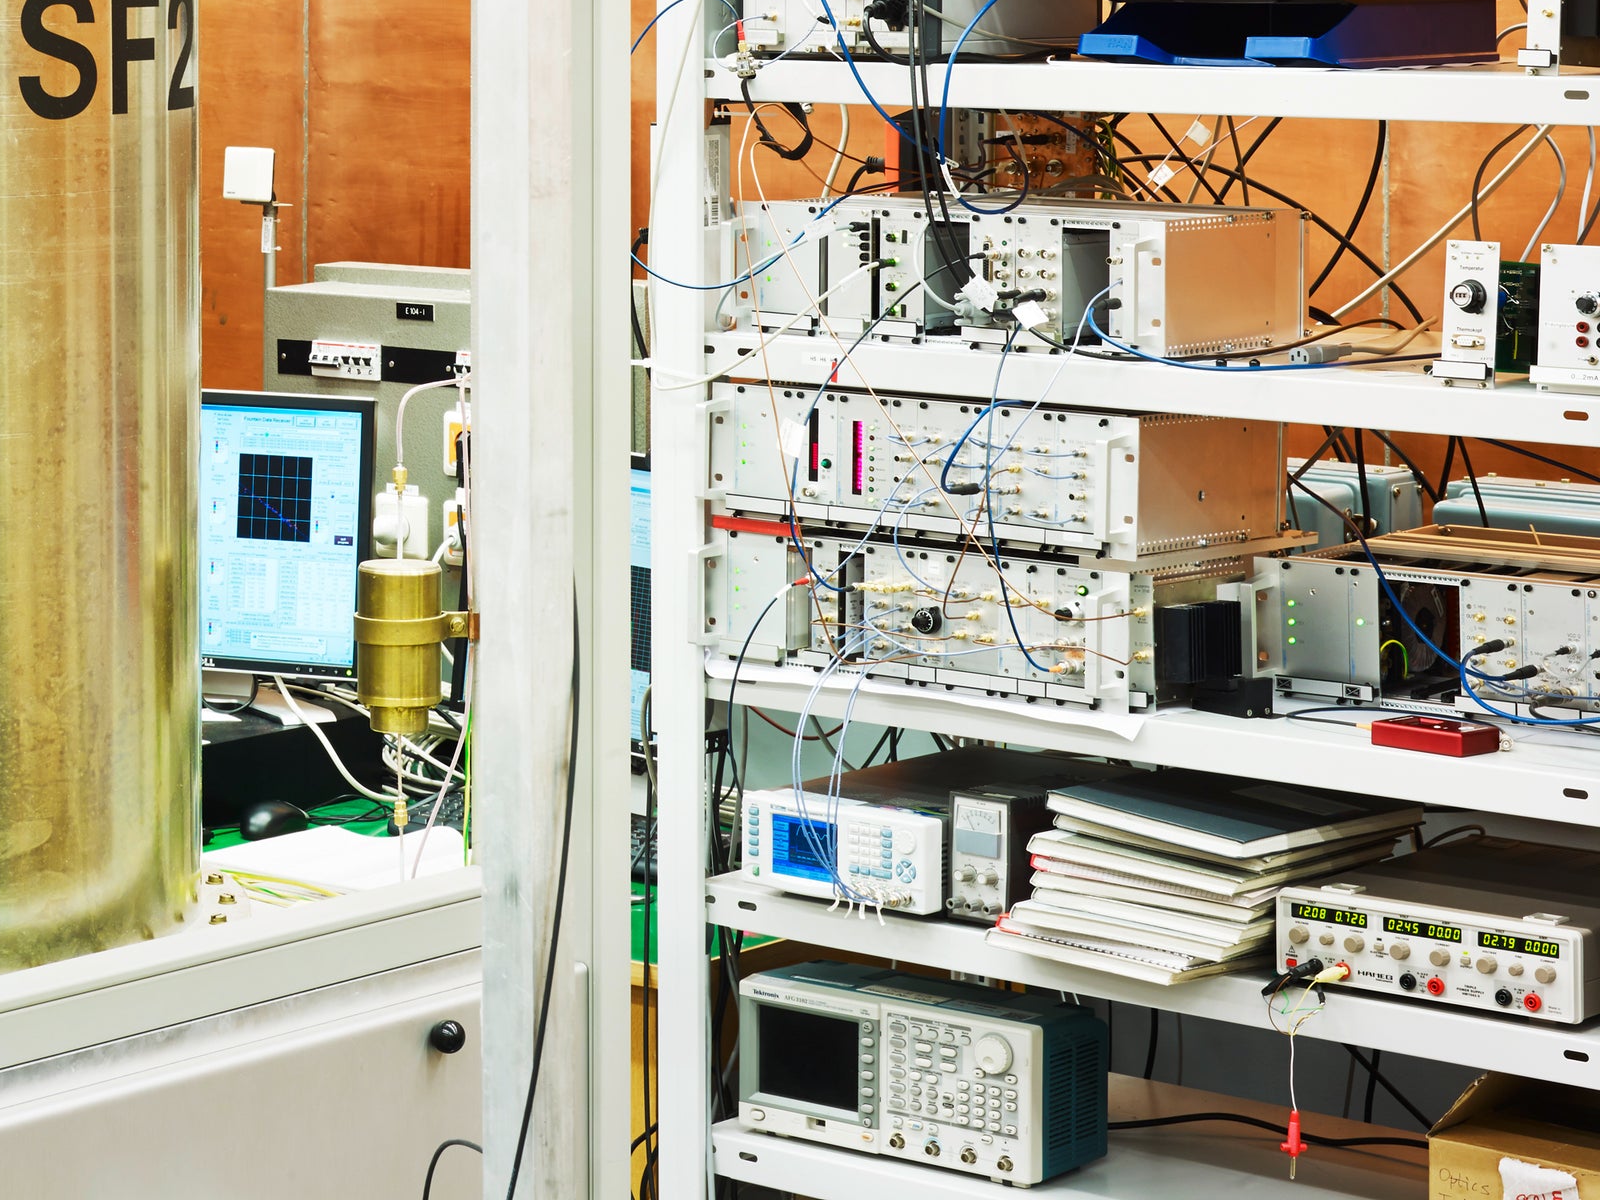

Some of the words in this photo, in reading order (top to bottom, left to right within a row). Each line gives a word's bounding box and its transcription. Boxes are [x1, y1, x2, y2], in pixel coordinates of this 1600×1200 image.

[1459, 264, 1485, 272] Temperatur
[405, 306, 409, 315] E
[1298, 905, 1327, 920] 12.08
[1334, 910, 1366, 926] 0.726
[1387, 919, 1419, 934] 02.45
[1427, 924, 1461, 941] 00.00
[1482, 933, 1516, 949] 02.79
[1524, 940, 1558, 956] 0.000
[753, 988, 779, 999] Tektronix
[1438, 1167, 1491, 1197] Optics
